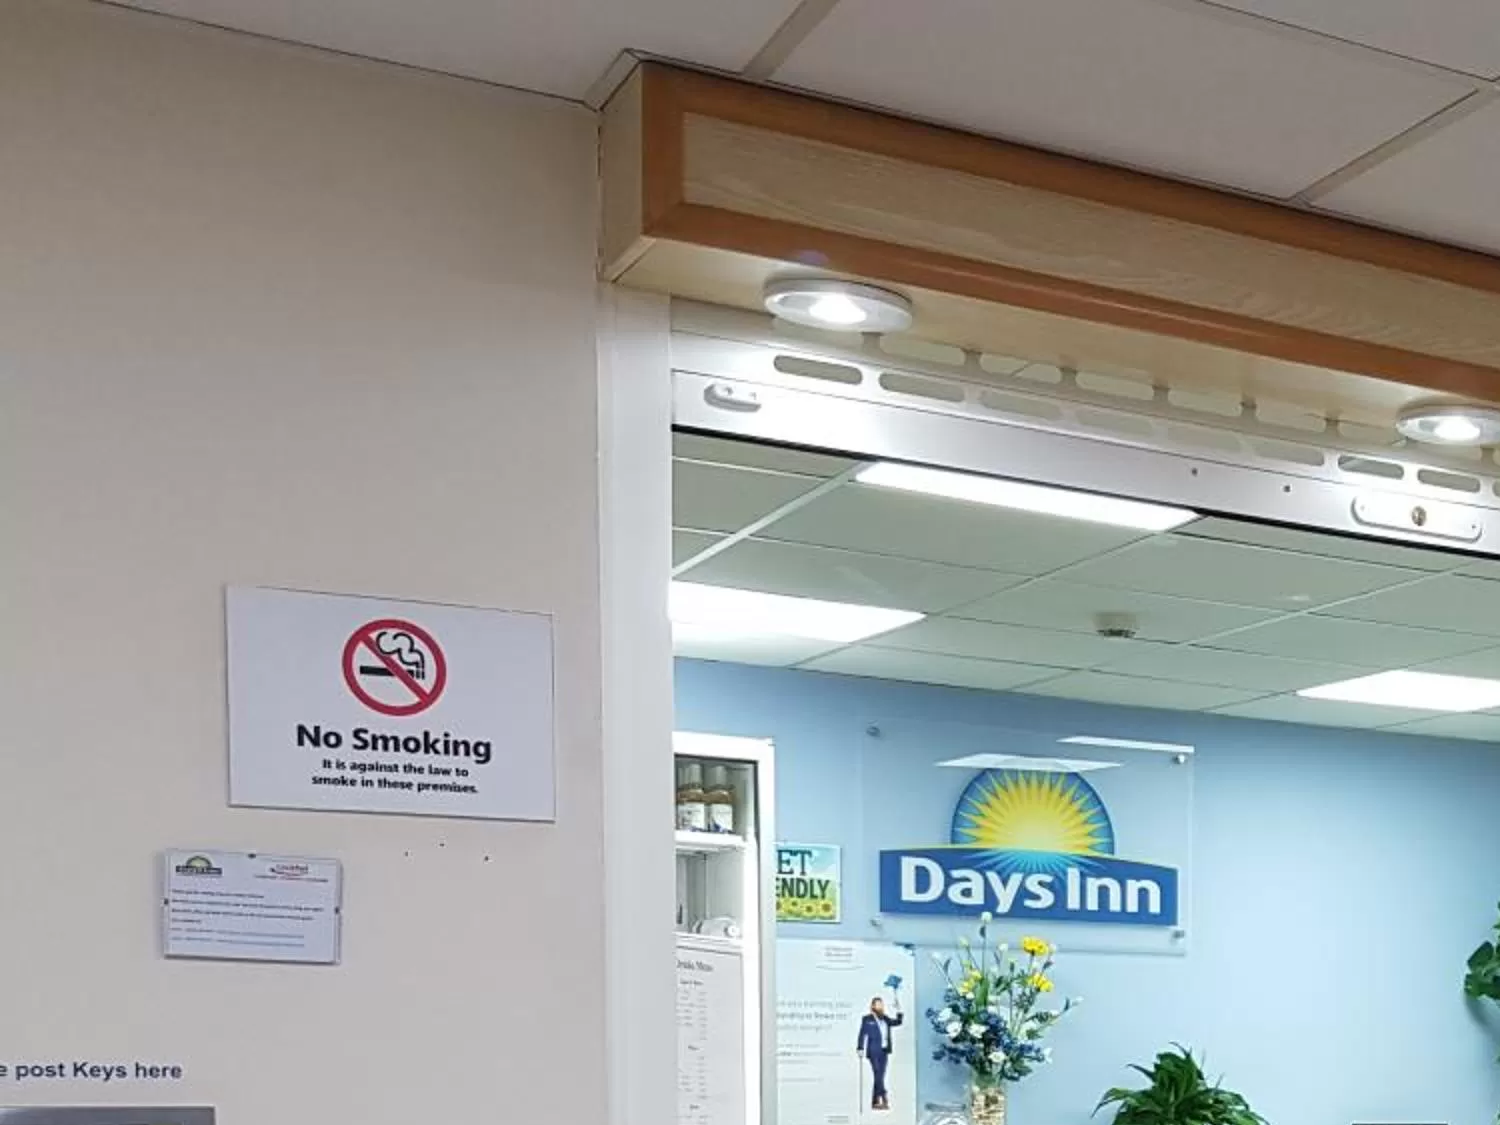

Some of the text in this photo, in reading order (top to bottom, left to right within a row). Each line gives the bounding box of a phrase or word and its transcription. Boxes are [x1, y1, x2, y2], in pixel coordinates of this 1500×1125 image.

[296, 723, 492, 765] No Smoking
[322, 758, 469, 778] It is against the law to
[311, 775, 479, 793] smoke in these premises.
[900, 855, 1161, 913] Days Inn
[15, 1062, 65, 1081] post
[73, 1061, 128, 1082] Keys
[135, 1061, 183, 1079] here
